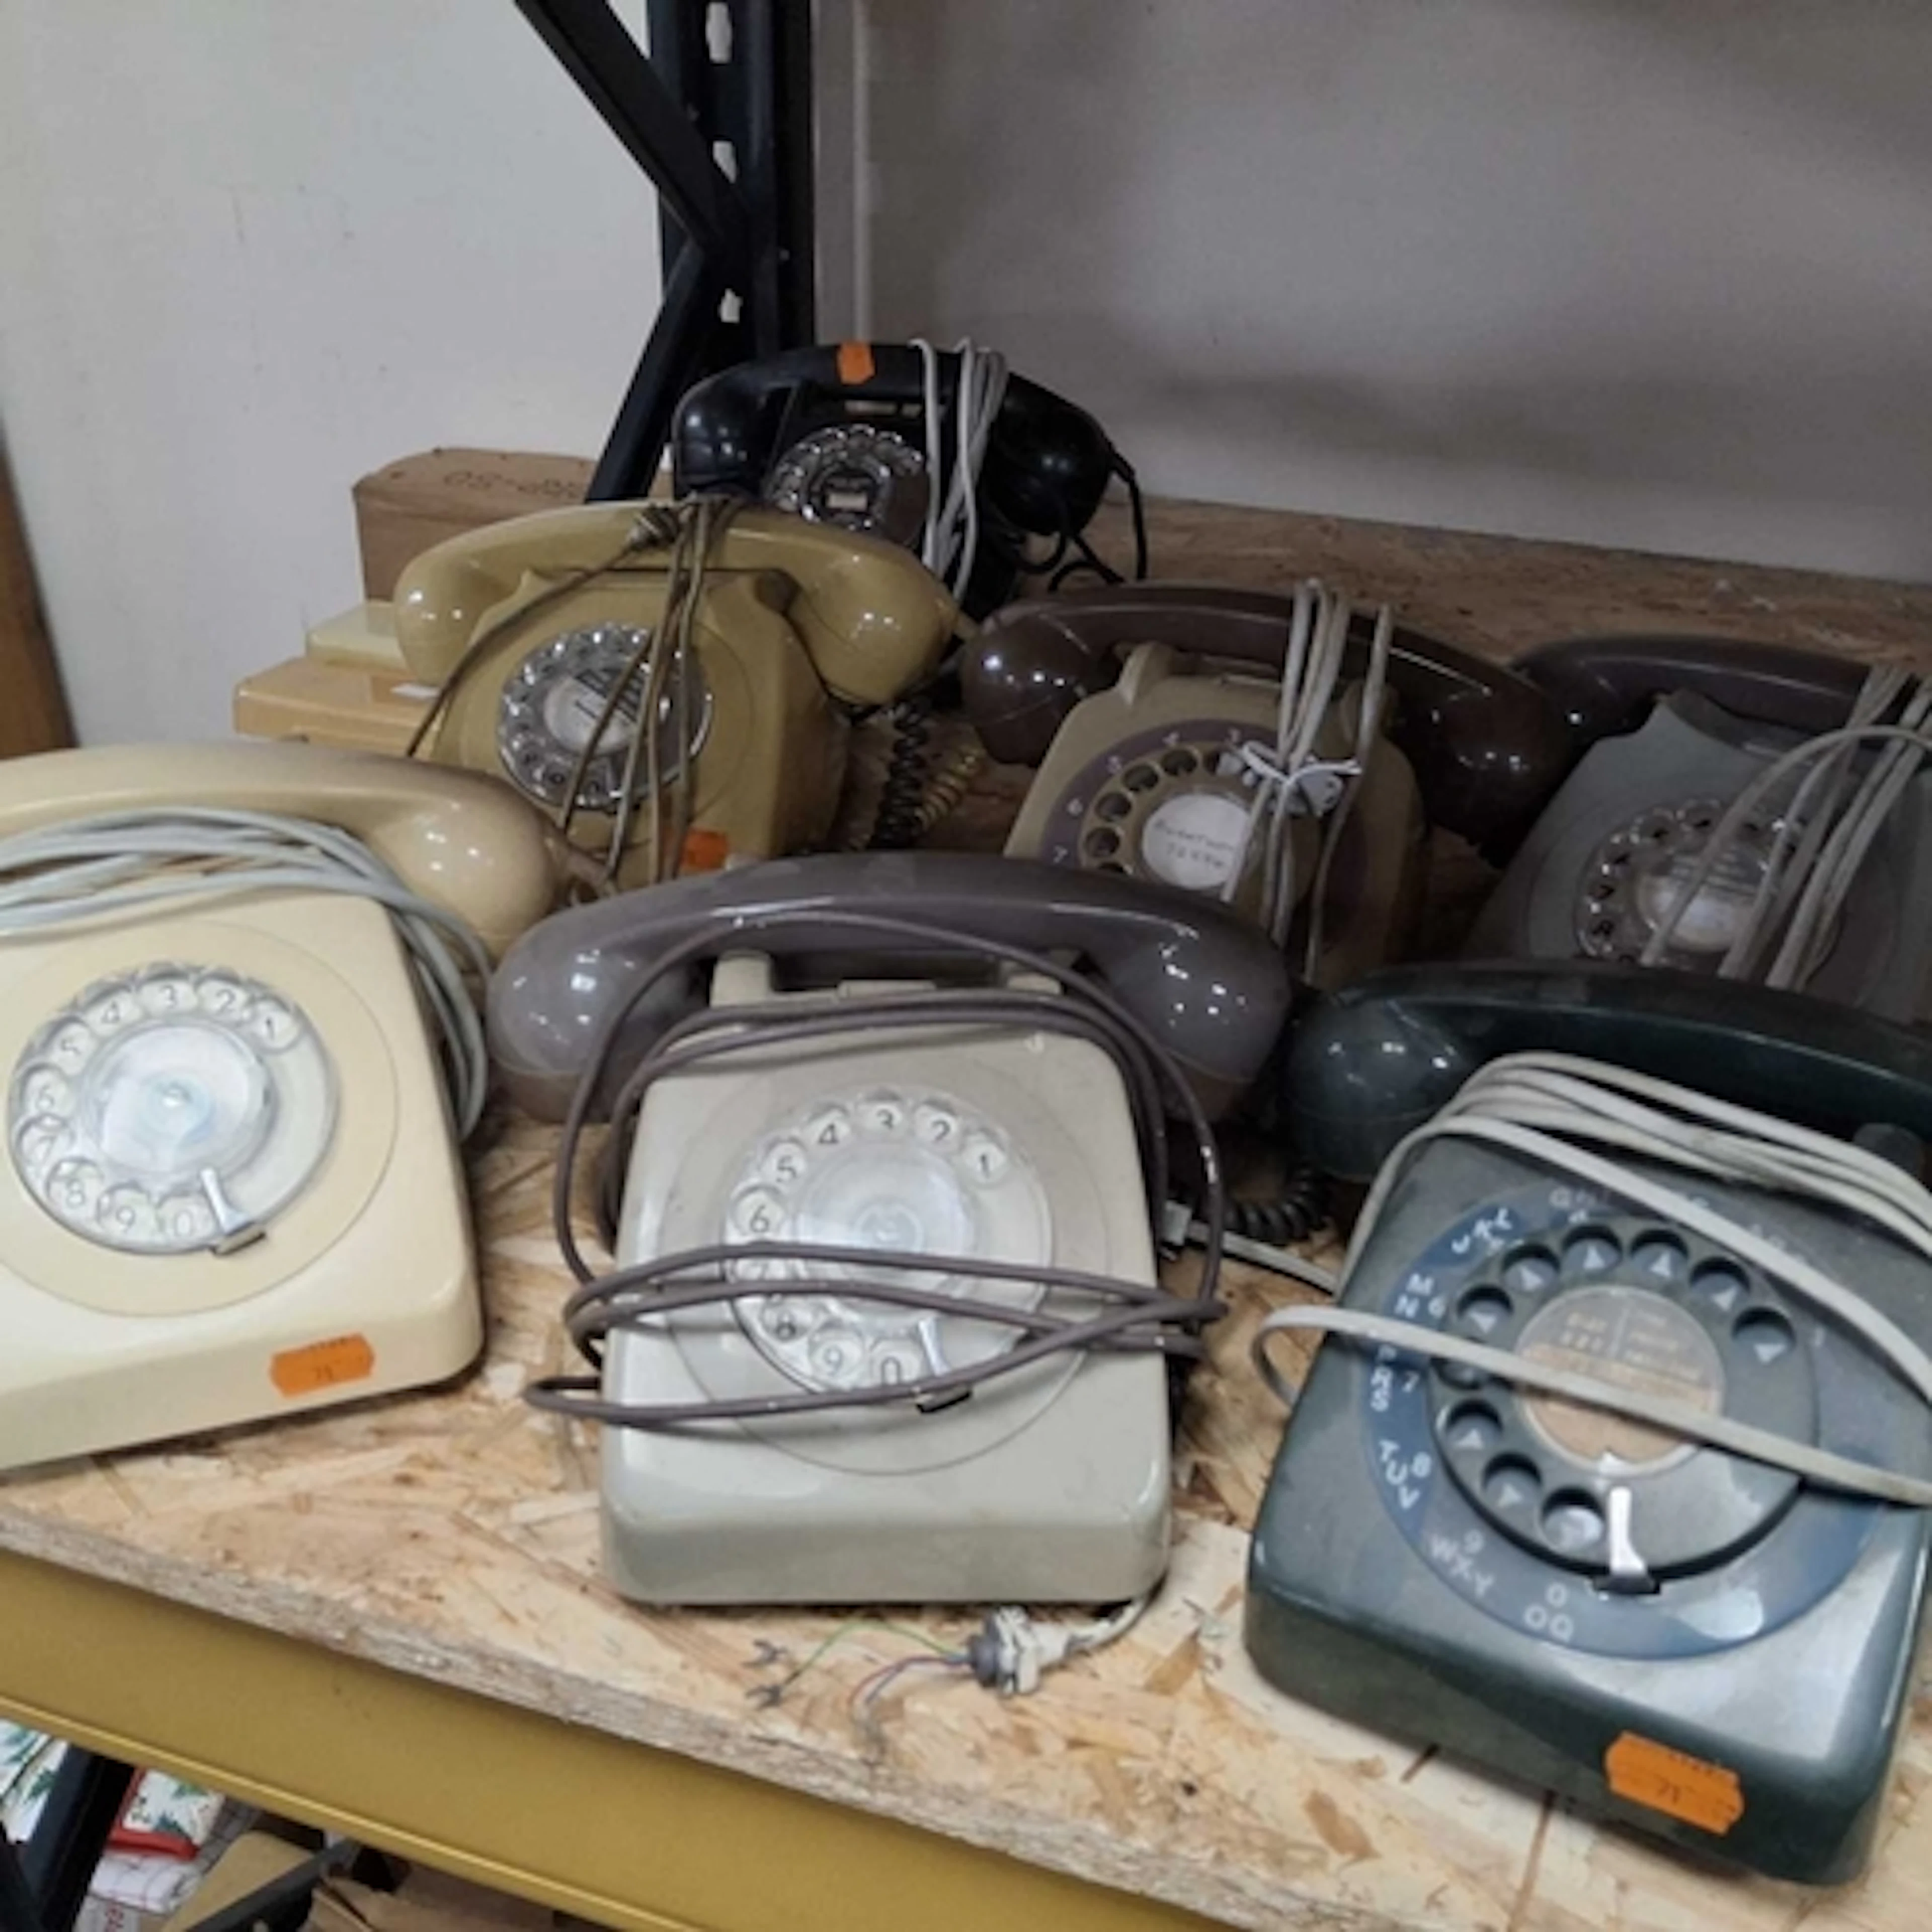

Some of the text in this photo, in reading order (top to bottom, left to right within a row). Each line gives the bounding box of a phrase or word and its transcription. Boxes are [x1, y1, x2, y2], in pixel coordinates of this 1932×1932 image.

[162, 984, 178, 1008] 3
[217, 989, 236, 1014] 2
[100, 1001, 120, 1024] 4
[264, 1016, 276, 1040] 1
[876, 1109, 894, 1130] 3
[931, 1119, 951, 1143] 2
[818, 1122, 839, 1145] 4
[776, 1156, 797, 1183] 5
[979, 1154, 990, 1177] 1
[65, 1177, 85, 1206] 8
[115, 1207, 136, 1233] 9
[173, 1209, 193, 1234] 0
[750, 1204, 769, 1233] 6
[1451, 1208, 1512, 1254] JKL
[1427, 1296, 1446, 1319] 6
[775, 1310, 797, 1342] 8
[823, 1345, 844, 1377] 9
[880, 1356, 902, 1384] 0
[1403, 1371, 1420, 1393] 7
[1379, 1439, 1420, 1509] TUV
[1412, 1452, 1432, 1478] 8
[1464, 1530, 1485, 1554] 9
[1430, 1533, 1494, 1598] WXY
